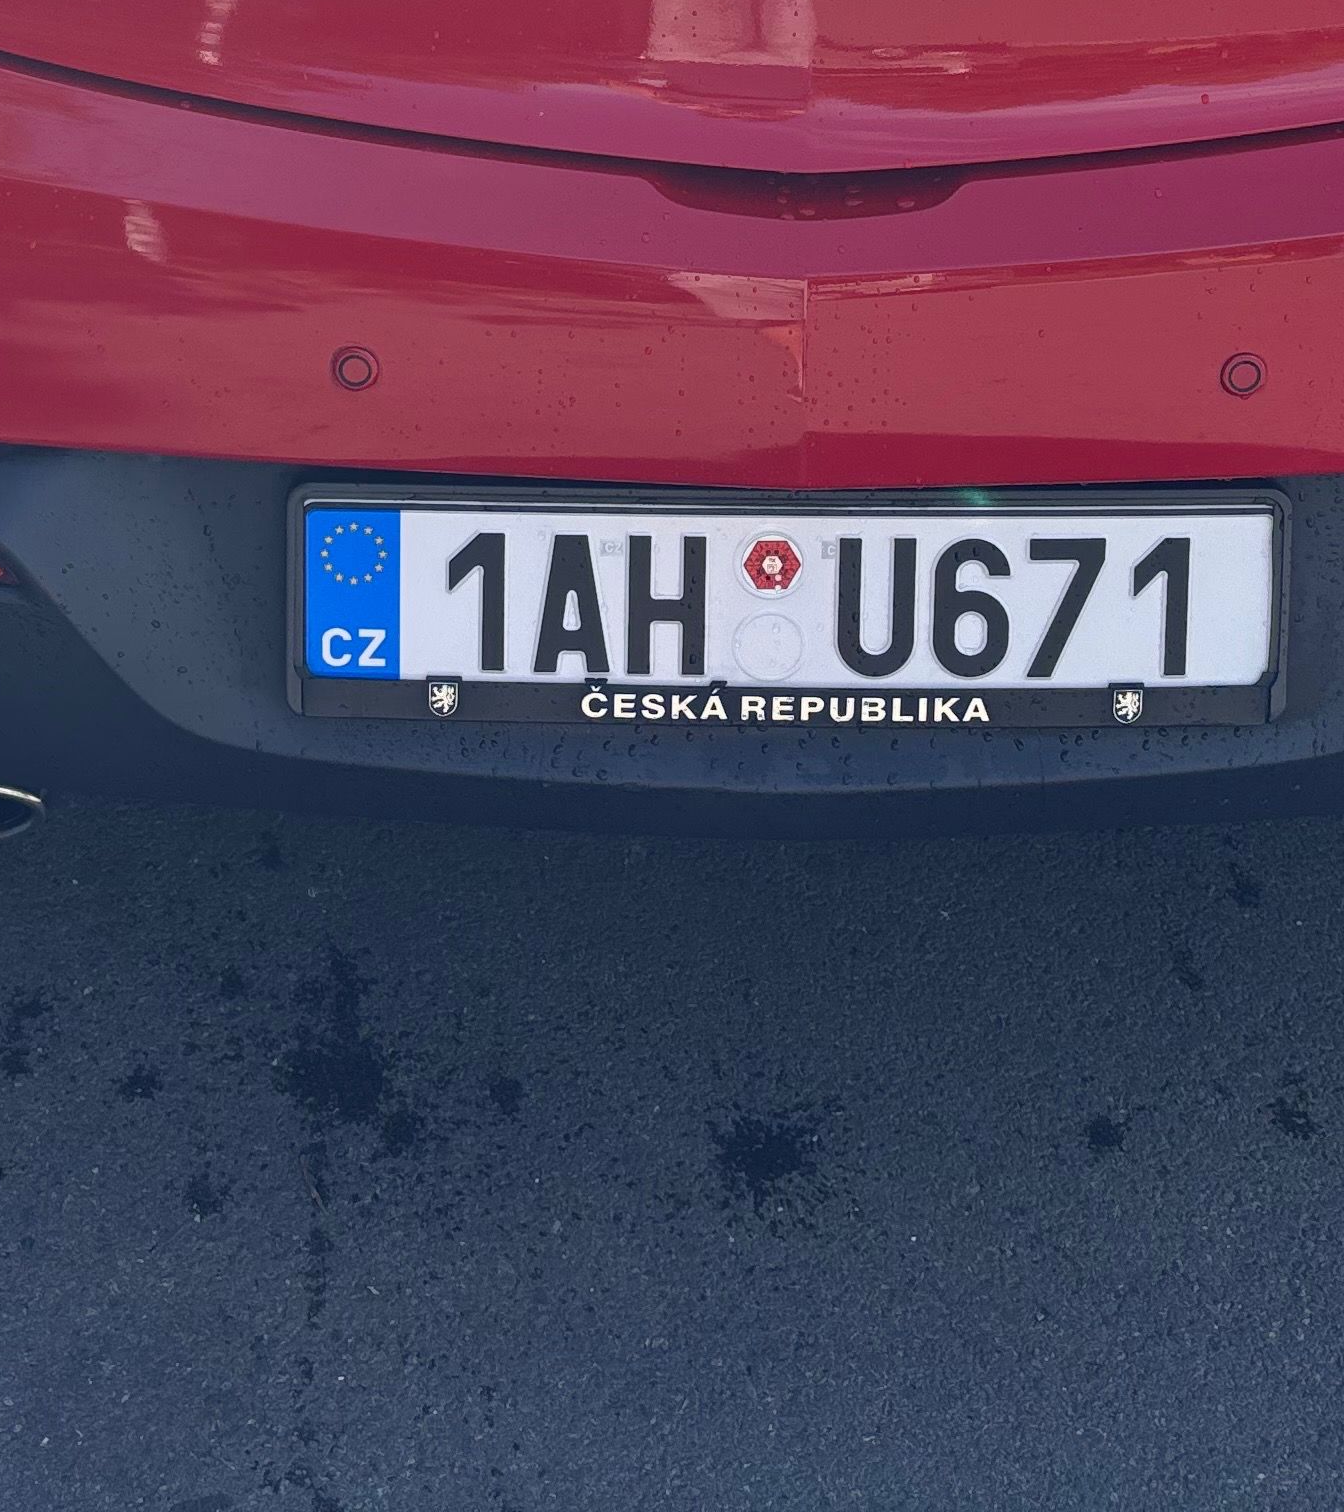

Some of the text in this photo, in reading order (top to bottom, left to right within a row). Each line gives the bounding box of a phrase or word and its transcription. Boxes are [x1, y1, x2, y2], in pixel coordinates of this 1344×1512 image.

[448, 532, 1191, 677] 1AH U671
[321, 627, 387, 667] CZ
[580, 685, 991, 723] ČESKÁ REPUBLIKA
